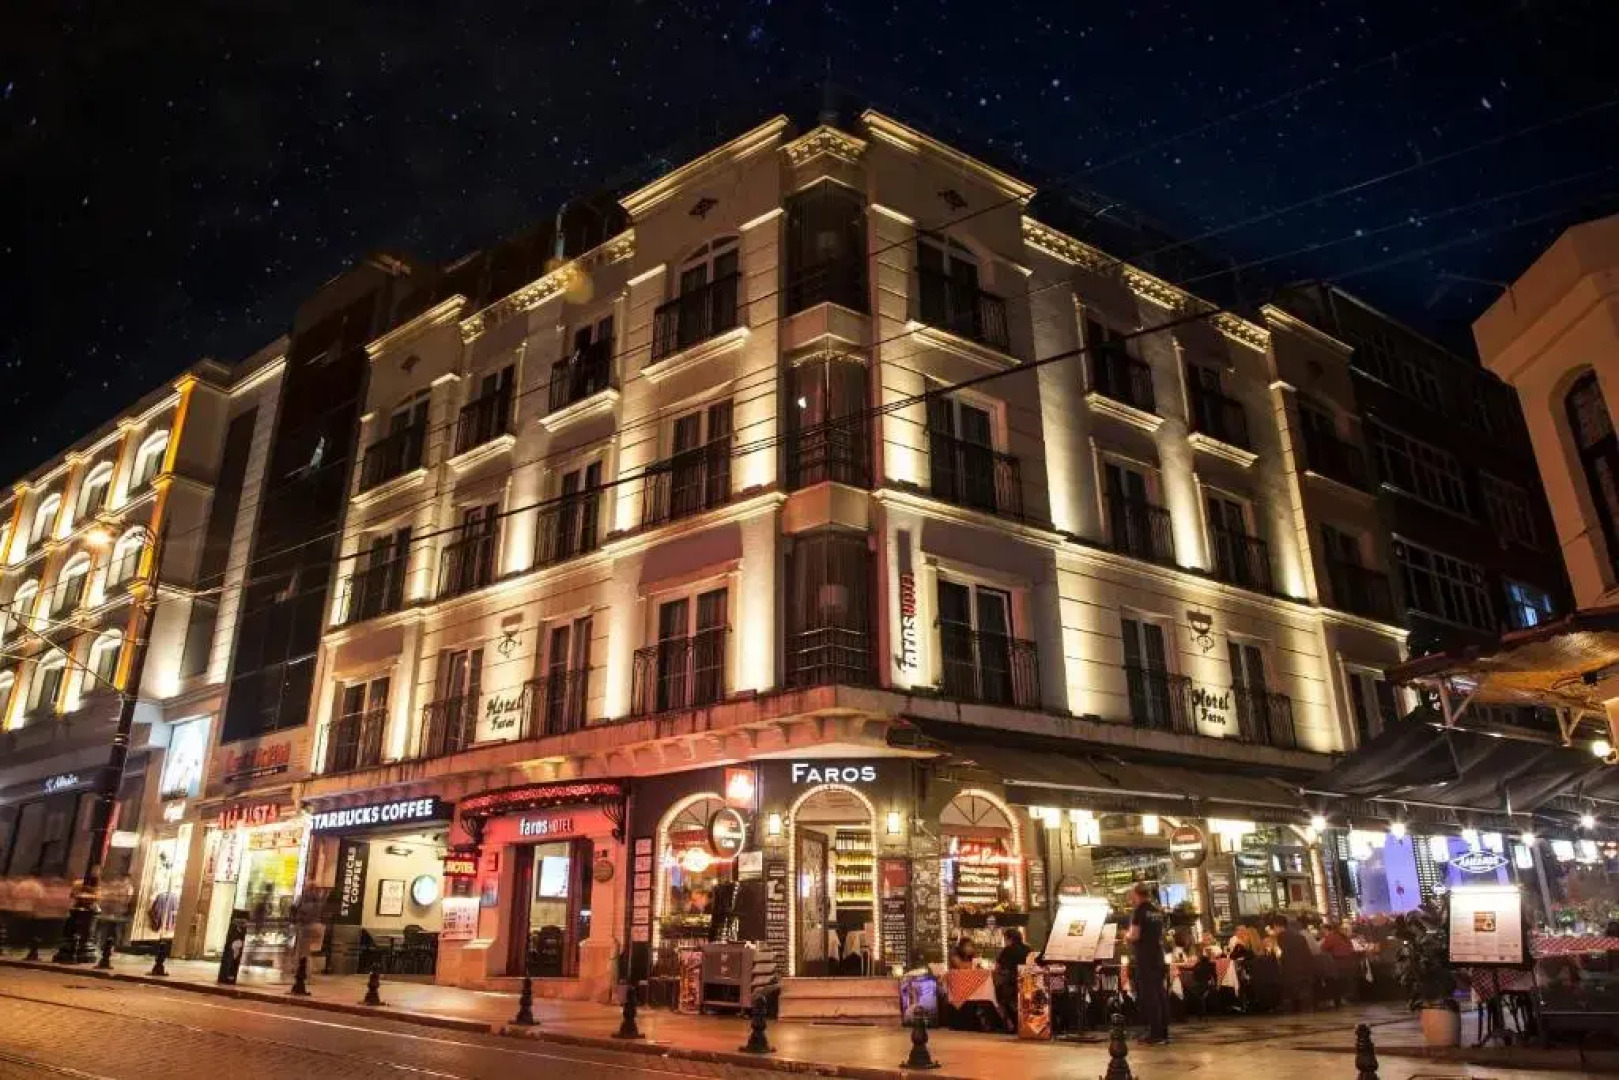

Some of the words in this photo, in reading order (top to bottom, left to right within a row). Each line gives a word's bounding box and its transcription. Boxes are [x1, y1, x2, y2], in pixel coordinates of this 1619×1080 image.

[791, 762, 877, 784] FAROS
[310, 804, 380, 830] TARBUCKS
[380, 799, 434, 822] COFFEE
[340, 846, 357, 917] STARBUCKS
[350, 859, 363, 904] COFFEE
